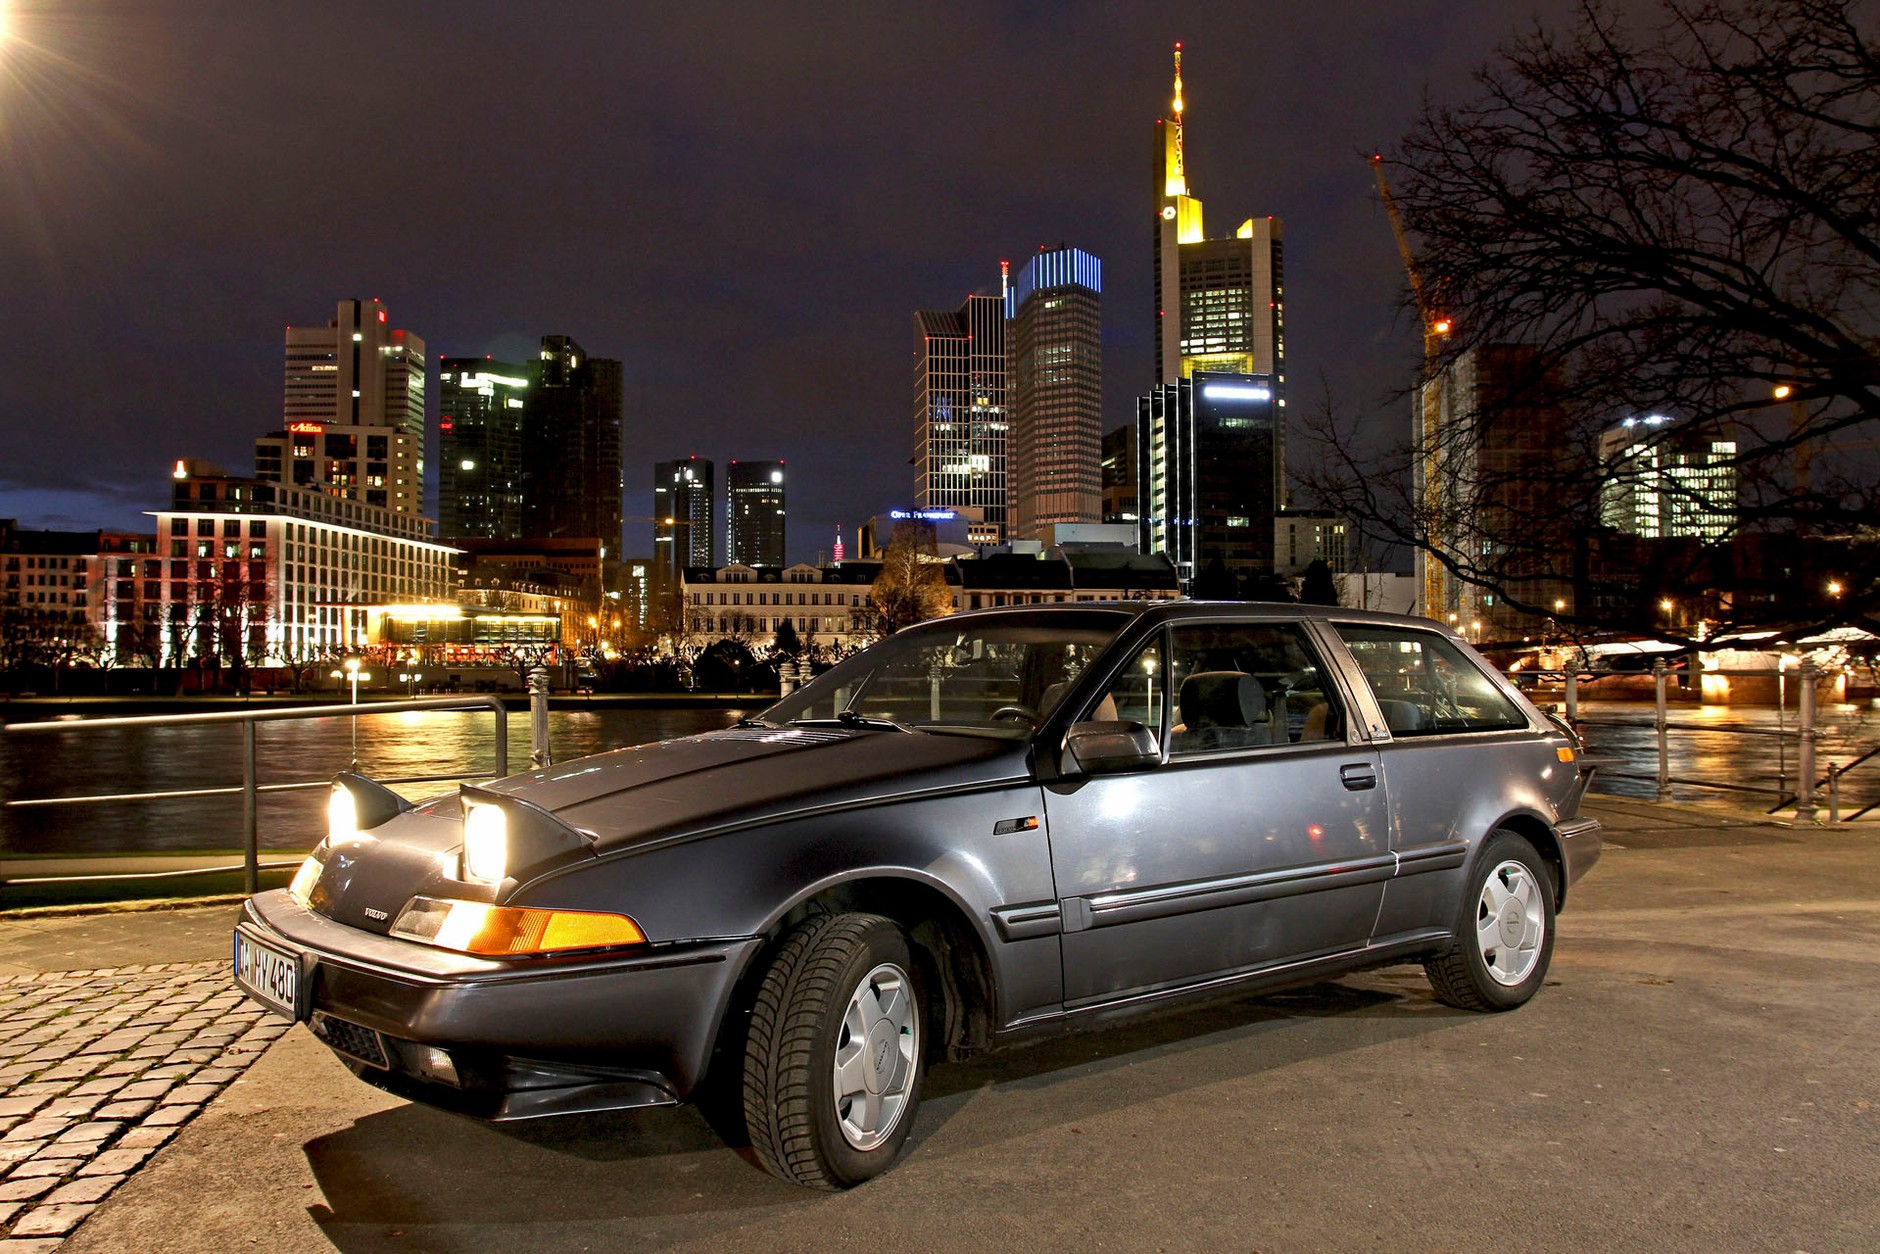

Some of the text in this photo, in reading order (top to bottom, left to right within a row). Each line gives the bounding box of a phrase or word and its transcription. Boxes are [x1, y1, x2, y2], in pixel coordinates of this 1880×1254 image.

[291, 422, 322, 432] Adina
[365, 907, 388, 921] VOLVO
[271, 957, 294, 1005] 480
